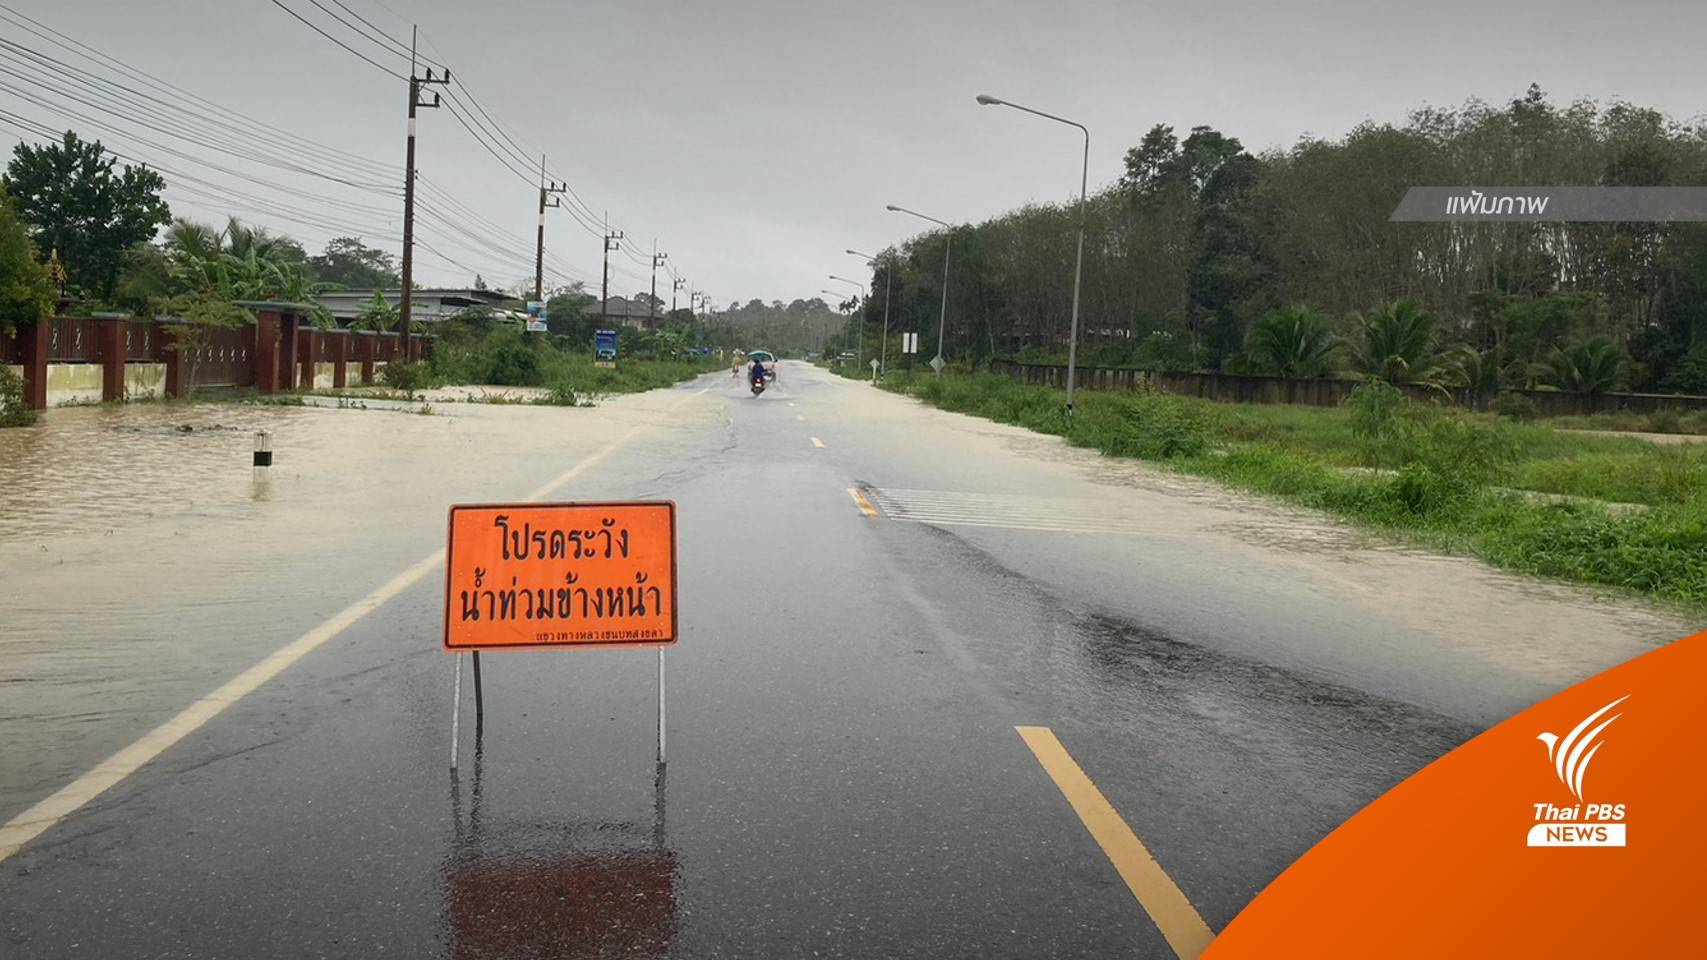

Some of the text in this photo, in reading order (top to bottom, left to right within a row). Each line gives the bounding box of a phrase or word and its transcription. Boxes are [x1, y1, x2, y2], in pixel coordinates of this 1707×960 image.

[494, 514, 629, 560] โปรดระวัง
[460, 567, 662, 621] น้ำท่วมข้างหน้า
